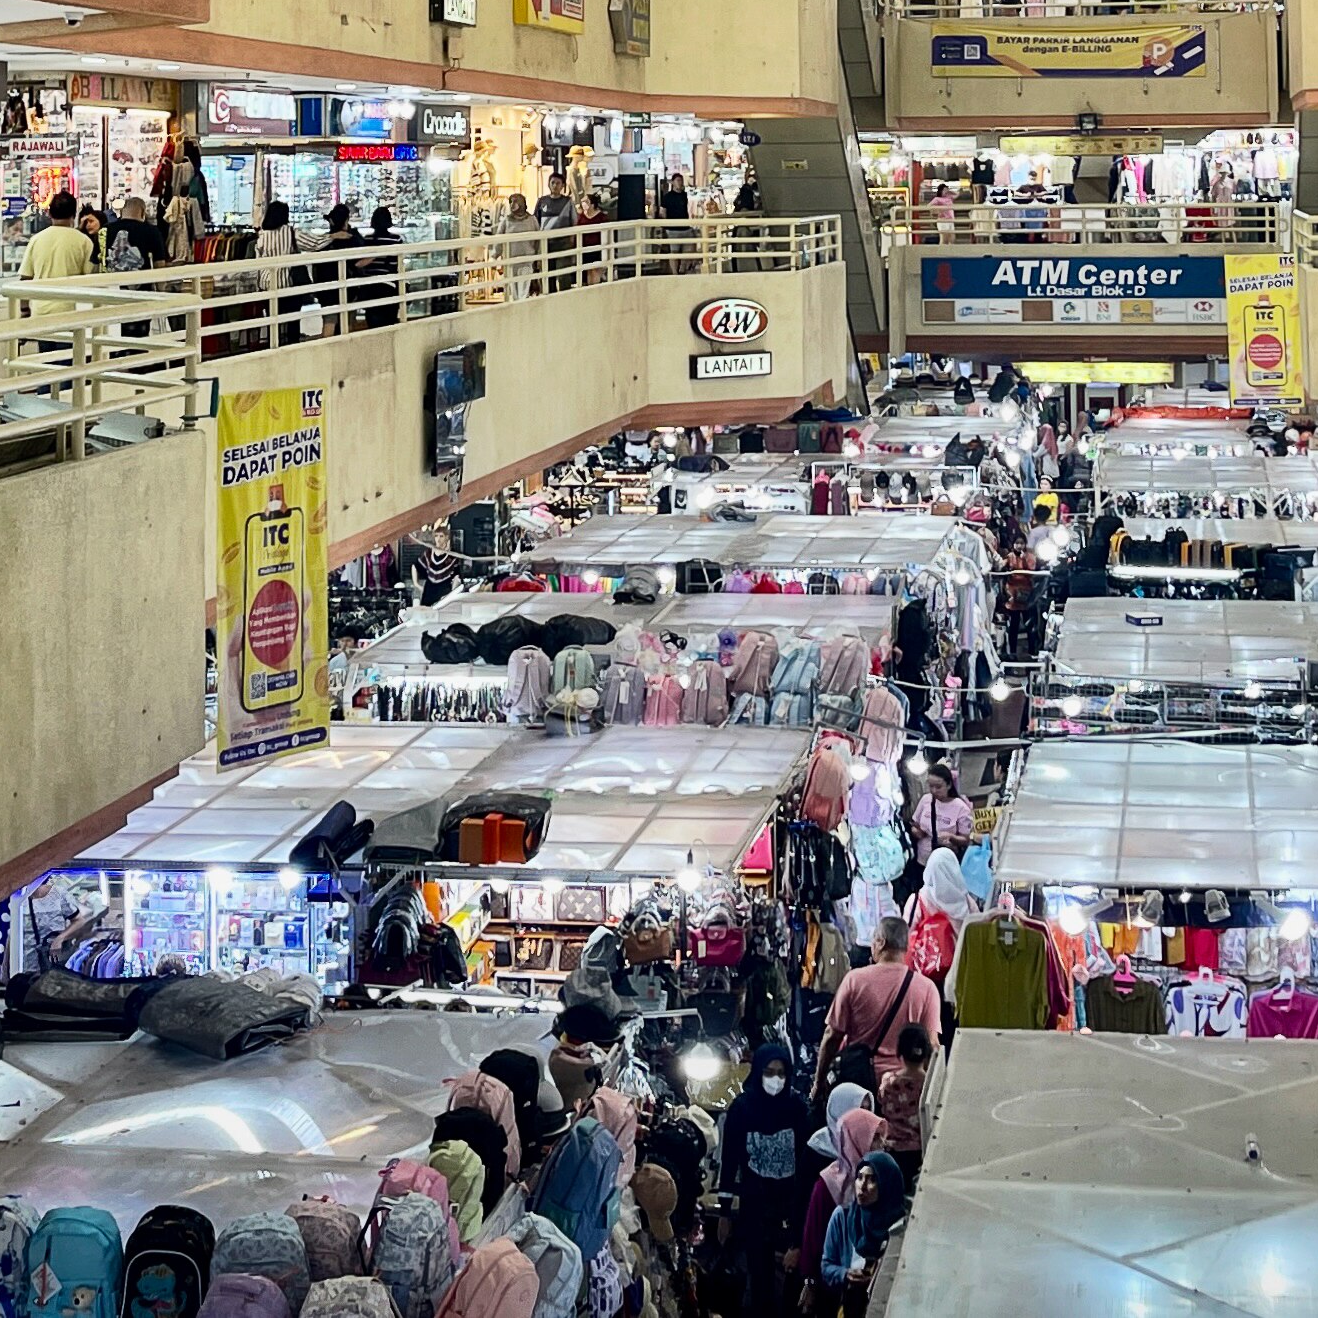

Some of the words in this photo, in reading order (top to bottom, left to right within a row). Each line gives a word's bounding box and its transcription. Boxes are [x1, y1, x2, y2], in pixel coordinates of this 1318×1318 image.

[996, 36, 1030, 45] BAYAR
[1072, 35, 1139, 44] LANGGANAN
[1022, 44, 1059, 54] dengan
[1061, 44, 1112, 53] E-BILLING
[12, 138, 64, 152] RAJAWALI
[1279, 256, 1294, 267] ITC
[992, 260, 1071, 285] ATM
[1078, 263, 1182, 285] Center
[1027, 286, 1044, 296] Lt.
[1046, 285, 1088, 296] Dasar
[1091, 285, 1124, 297] Blok
[1134, 285, 1146, 296] D
[1229, 282, 1264, 293] DAPAT
[1267, 278, 1294, 289] POIN
[1255, 311, 1274, 321] ITC
[704, 358, 753, 374] LANTAI
[302, 389, 323, 409] ITC
[223, 441, 270, 463] SELESAI
[272, 426, 321, 451] BELANJA
[223, 453, 277, 485] DAPAT
[282, 442, 321, 470] POIN
[263, 523, 290, 548] ITC
